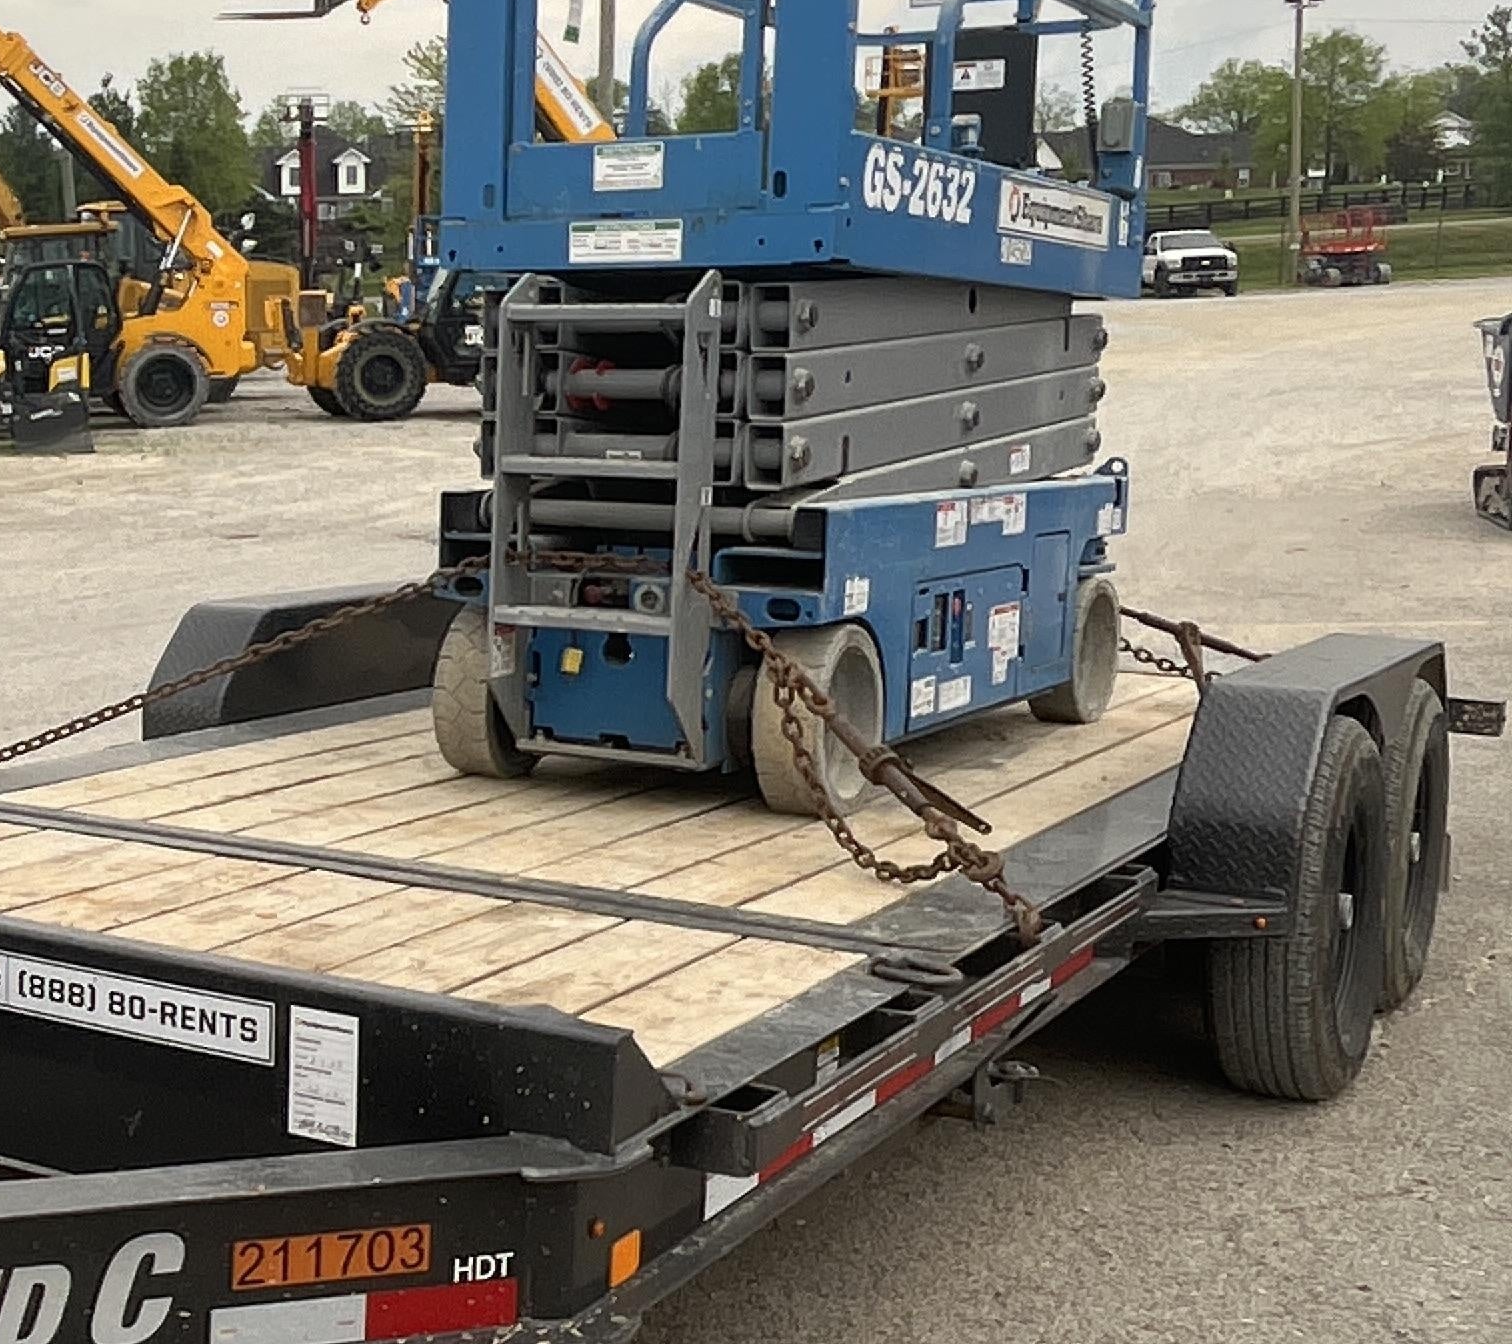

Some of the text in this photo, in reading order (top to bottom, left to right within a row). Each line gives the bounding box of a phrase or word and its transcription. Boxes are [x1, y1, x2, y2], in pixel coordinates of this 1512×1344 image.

[29, 61, 66, 97] JCB
[863, 142, 976, 224] GS-2632
[18, 969, 259, 1043] (888) 80-RENTS
[237, 1227, 426, 1286] 211703
[453, 1251, 515, 1284] HDT
